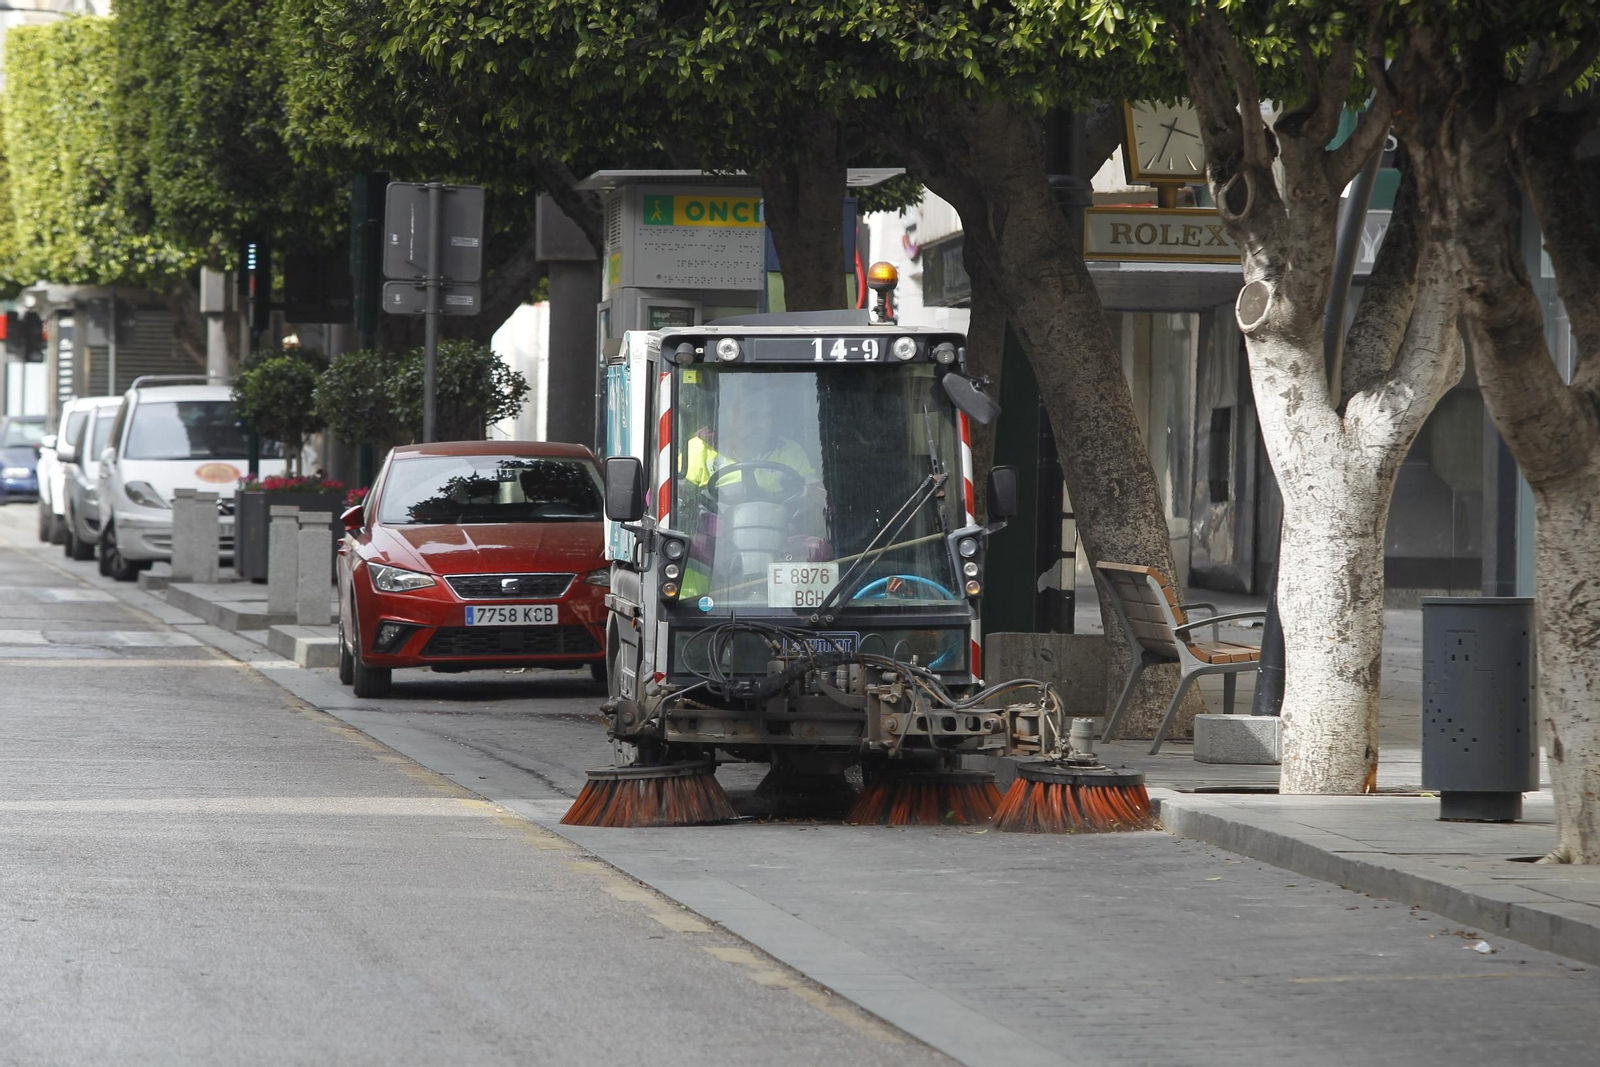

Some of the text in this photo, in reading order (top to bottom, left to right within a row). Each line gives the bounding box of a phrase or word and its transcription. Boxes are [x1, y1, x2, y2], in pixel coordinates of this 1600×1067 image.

[1110, 223, 1229, 247] ROLEX
[811, 338, 879, 362] 14-9
[773, 568, 830, 584] E 8976
[795, 590, 824, 606] BGH
[477, 608, 518, 623] 7758
[523, 607, 554, 622] KCB
